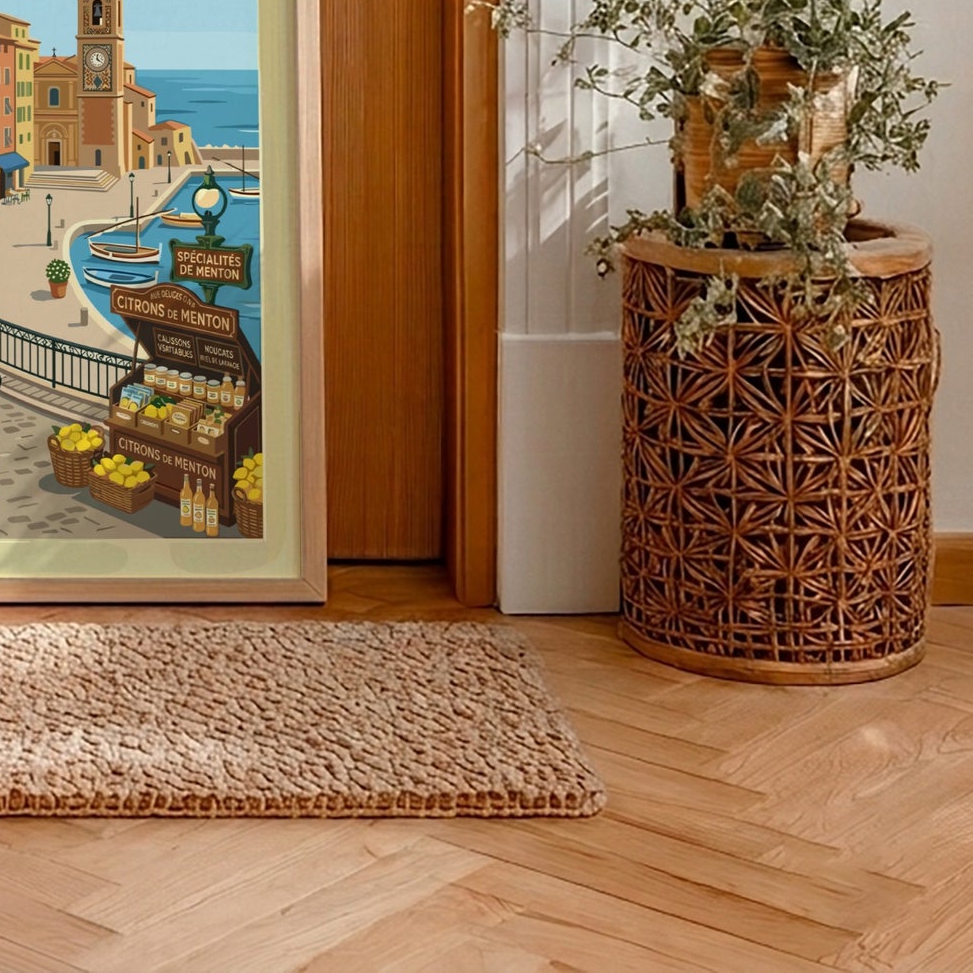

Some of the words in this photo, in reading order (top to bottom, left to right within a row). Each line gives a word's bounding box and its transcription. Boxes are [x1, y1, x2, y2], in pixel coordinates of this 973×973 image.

[177, 250, 242, 267] SPÉCIALITÉS
[179, 264, 193, 276] DE
[195, 266, 240, 280] MENTON
[117, 295, 165, 318] CITRONS
[167, 308, 178, 320] DE
[180, 309, 230, 332] MENTON
[118, 437, 161, 461] CITRONS
[162, 454, 173, 465] DE
[174, 456, 217, 480] MENTON
